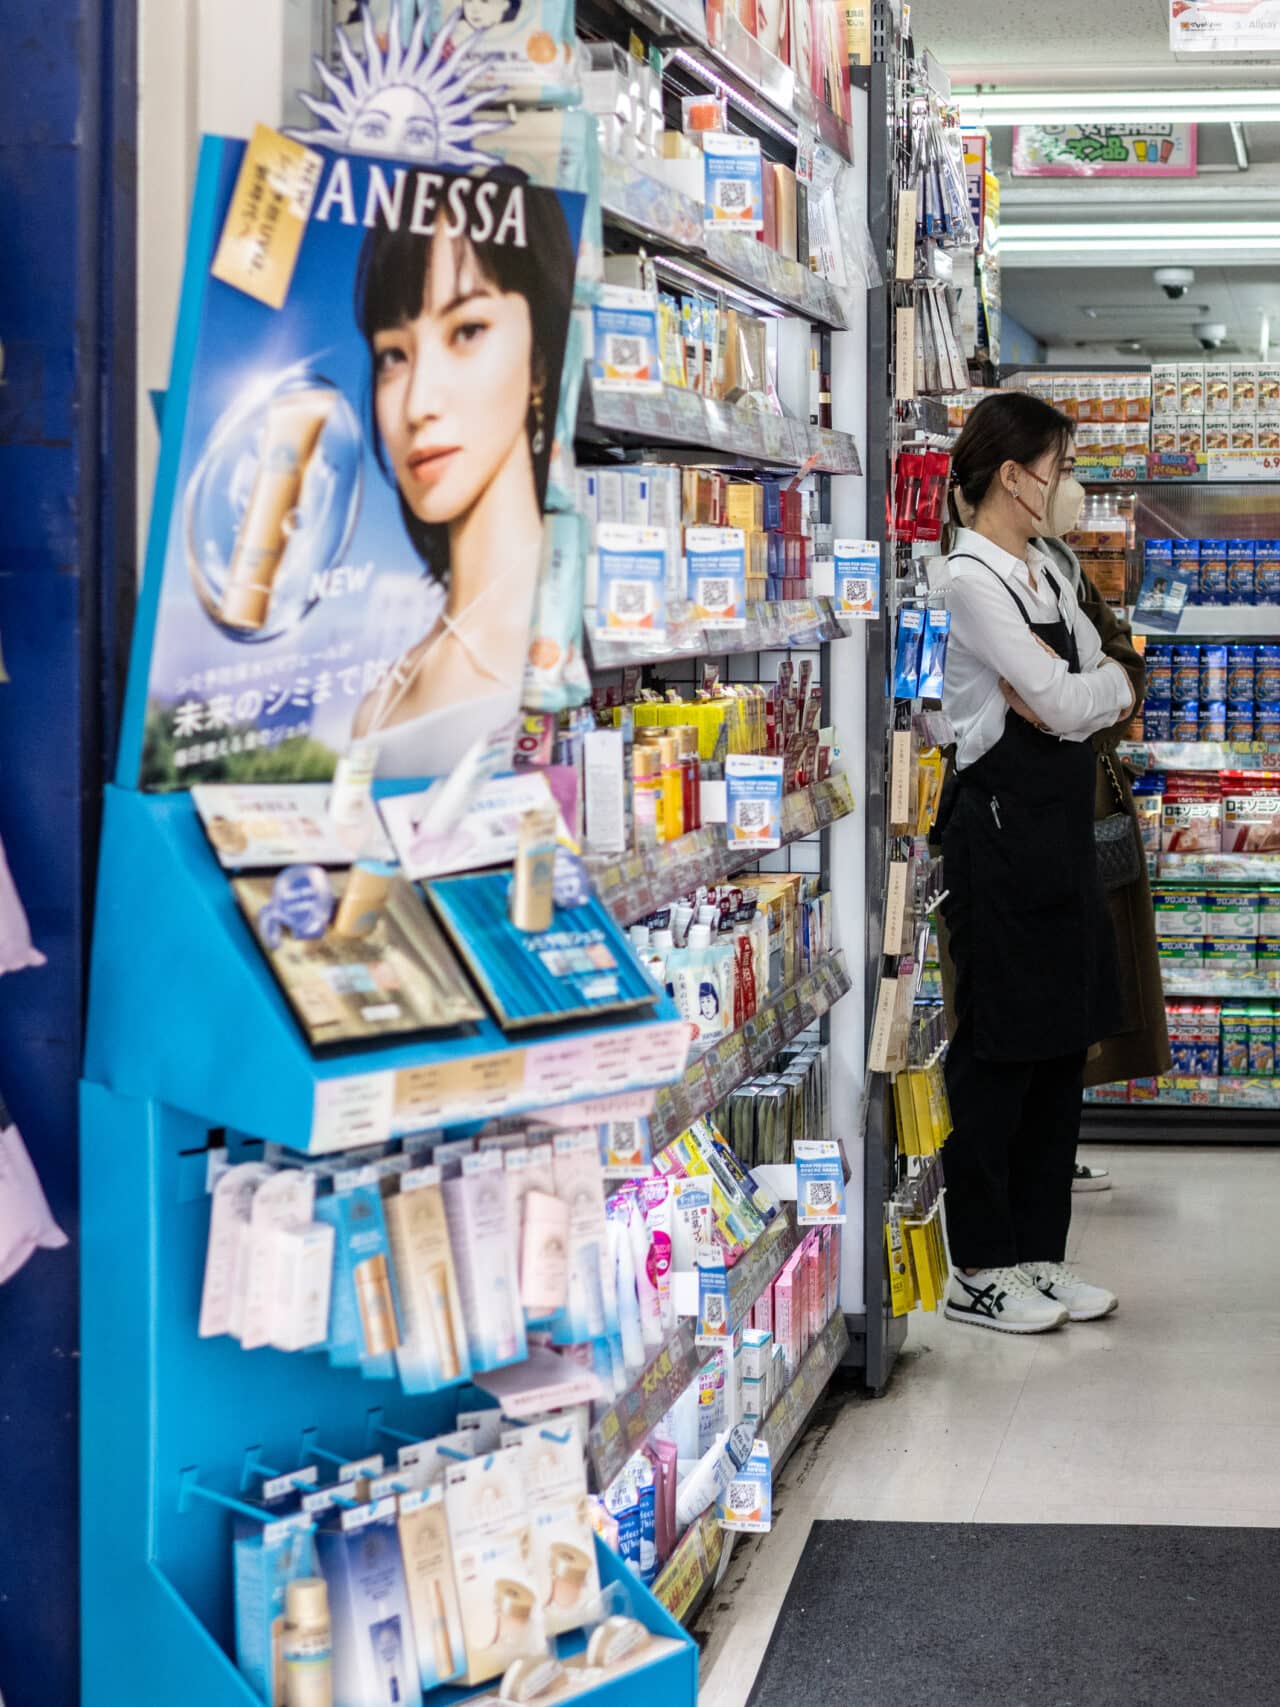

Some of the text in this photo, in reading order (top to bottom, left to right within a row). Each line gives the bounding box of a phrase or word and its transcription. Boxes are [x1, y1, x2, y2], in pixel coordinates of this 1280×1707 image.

[315, 158, 529, 249] ANESSA
[1111, 467, 1136, 480] 4480
[308, 562, 374, 601] NEW
